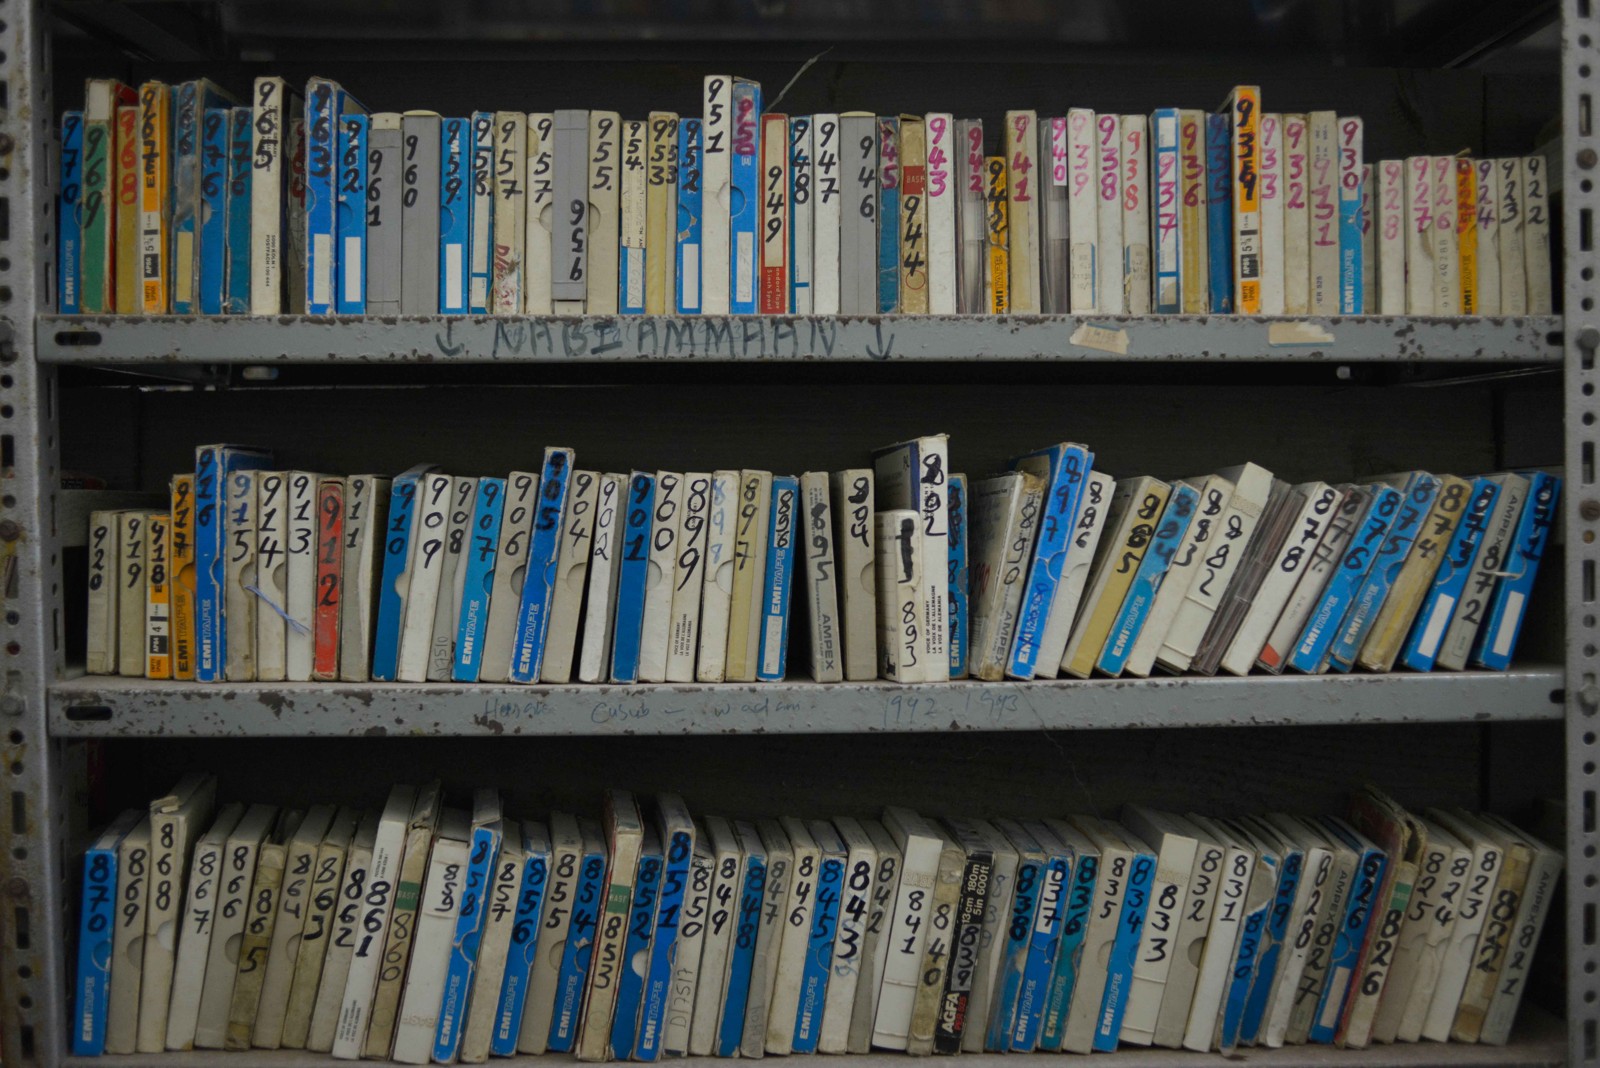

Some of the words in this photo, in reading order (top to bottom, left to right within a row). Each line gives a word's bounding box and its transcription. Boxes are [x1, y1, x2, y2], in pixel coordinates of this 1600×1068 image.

[231, 110, 250, 195] 976
[254, 81, 278, 169] 965
[649, 119, 667, 185] 953
[705, 79, 725, 153] 951
[733, 98, 756, 155] 950
[1053, 117, 1066, 181] 940
[63, 115, 78, 205] 970
[85, 128, 102, 229] 969
[121, 111, 137, 206] 968
[201, 114, 226, 197] 976
[368, 150, 382, 226] 961
[404, 135, 418, 207] 960
[497, 121, 522, 199] 957
[534, 119, 552, 203] 957
[681, 120, 700, 193] 952
[792, 119, 809, 204] 948
[818, 122, 839, 203] 947
[928, 118, 947, 197] 943
[968, 127, 983, 192] 942
[1012, 115, 1032, 201] 941
[1072, 115, 1089, 196] 939
[1099, 115, 1119, 200] 938
[1124, 131, 1141, 211] 938
[1209, 113, 1231, 204] 935
[1262, 118, 1277, 199] 933
[1287, 122, 1305, 209] 932
[1342, 121, 1358, 189] 930
[1527, 159, 1546, 224] 922
[766, 166, 784, 242] 949
[1159, 154, 1178, 242] 937
[1384, 162, 1400, 240] 928
[1413, 157, 1433, 233] 927
[1435, 157, 1452, 230] 926
[1478, 161, 1494, 229] 924
[1500, 161, 1518, 224] 923
[66, 240, 74, 305] EMITAPE
[904, 196, 923, 276] 944
[1345, 249, 1354, 313] EMITAPE
[198, 449, 215, 527] 916
[232, 475, 252, 562] 915
[259, 476, 283, 568] 914
[347, 480, 364, 548] 911
[389, 483, 415, 554] 910
[423, 477, 448, 568] 909
[450, 482, 471, 553] 908
[476, 483, 498, 562] 907
[504, 475, 532, 555] 906
[536, 452, 566, 530] 905
[569, 474, 592, 547] 904
[594, 481, 615, 560] 902
[624, 475, 651, 560] 901
[654, 475, 678, 551] 900
[736, 478, 759, 570] 897
[849, 477, 869, 547] 894
[1379, 482, 1436, 556] 875
[1418, 484, 1464, 558] 874
[1497, 495, 1518, 547] AMPEX
[90, 526, 107, 590] 920
[127, 518, 142, 588] 919
[151, 521, 165, 584] 918
[319, 495, 339, 606] 912
[677, 479, 709, 591] 899
[1281, 489, 1336, 572] 878
[1344, 492, 1399, 570] 876
[771, 550, 785, 614] EMITAPE
[1344, 584, 1379, 645] EMITAPE
[1462, 546, 1501, 624] 872
[178, 595, 189, 673] EMITAPE
[203, 599, 211, 669] EMITAPE
[462, 600, 479, 665] EMITAPE
[520, 603, 539, 673] EMITAPE
[822, 614, 835, 670] AMPEX
[903, 601, 917, 667] 893
[994, 611, 1013, 666] AMPEX
[1112, 596, 1145, 657] EMITAPE
[1300, 595, 1339, 655] EMITAPE
[884, 695, 937, 726] 1992
[88, 854, 109, 932] 870
[123, 849, 147, 927] 869
[156, 823, 174, 911] 868
[223, 846, 249, 918] 866
[284, 854, 311, 918] 864
[460, 840, 488, 916] 858
[490, 863, 515, 922] 857
[512, 858, 546, 944] 856
[546, 854, 576, 928] 855
[573, 858, 603, 933] 854
[632, 859, 659, 940] 852
[657, 831, 691, 928] 851
[681, 867, 710, 937] 850
[712, 858, 737, 935] 849
[765, 861, 786, 924] 847
[789, 855, 814, 927] 846
[815, 861, 841, 938] 845
[867, 858, 895, 933] 842
[962, 897, 974, 924] 13cm
[969, 864, 980, 892] 180m
[976, 865, 990, 895] 600ft
[1009, 864, 1037, 941] 838
[1043, 861, 1066, 927] 837
[1065, 857, 1097, 935] 836
[1099, 857, 1126, 918] 835
[1127, 859, 1151, 933] 834
[1187, 850, 1222, 922] 832
[1220, 855, 1248, 922] 831
[1273, 855, 1301, 927] 829
[1328, 870, 1347, 921] AMPEX
[1409, 852, 1445, 921] 825
[1435, 858, 1470, 926] 824
[1460, 851, 1497, 919] 823
[1528, 870, 1550, 924] AMPEX
[240, 889, 267, 973] 865
[334, 868, 365, 947] 862
[355, 881, 391, 957] 861
[836, 861, 870, 958] 843
[901, 890, 924, 954] 841
[973, 899, 983, 916] 5in
[1144, 884, 1178, 962] 833
[382, 913, 411, 981] 860
[594, 916, 621, 989] 853
[923, 904, 950, 986] 840
[958, 926, 979, 985] 839
[1234, 913, 1260, 978] 830
[1296, 924, 1334, 1005] 827
[1362, 909, 1402, 996] 826
[1501, 924, 1535, 995] 821
[440, 975, 460, 1045] EMITAPE
[500, 976, 519, 1039] EMITAPE
[558, 975, 578, 1038] EMITAPE
[643, 981, 663, 1050] EMITAPE
[800, 976, 818, 1039] EMITAPE
[943, 993, 960, 1033] AGFA
[1016, 980, 1036, 1042] EMITAPE
[1046, 975, 1066, 1038] EMITAPE
[1101, 973, 1122, 1035] EMITAPE
